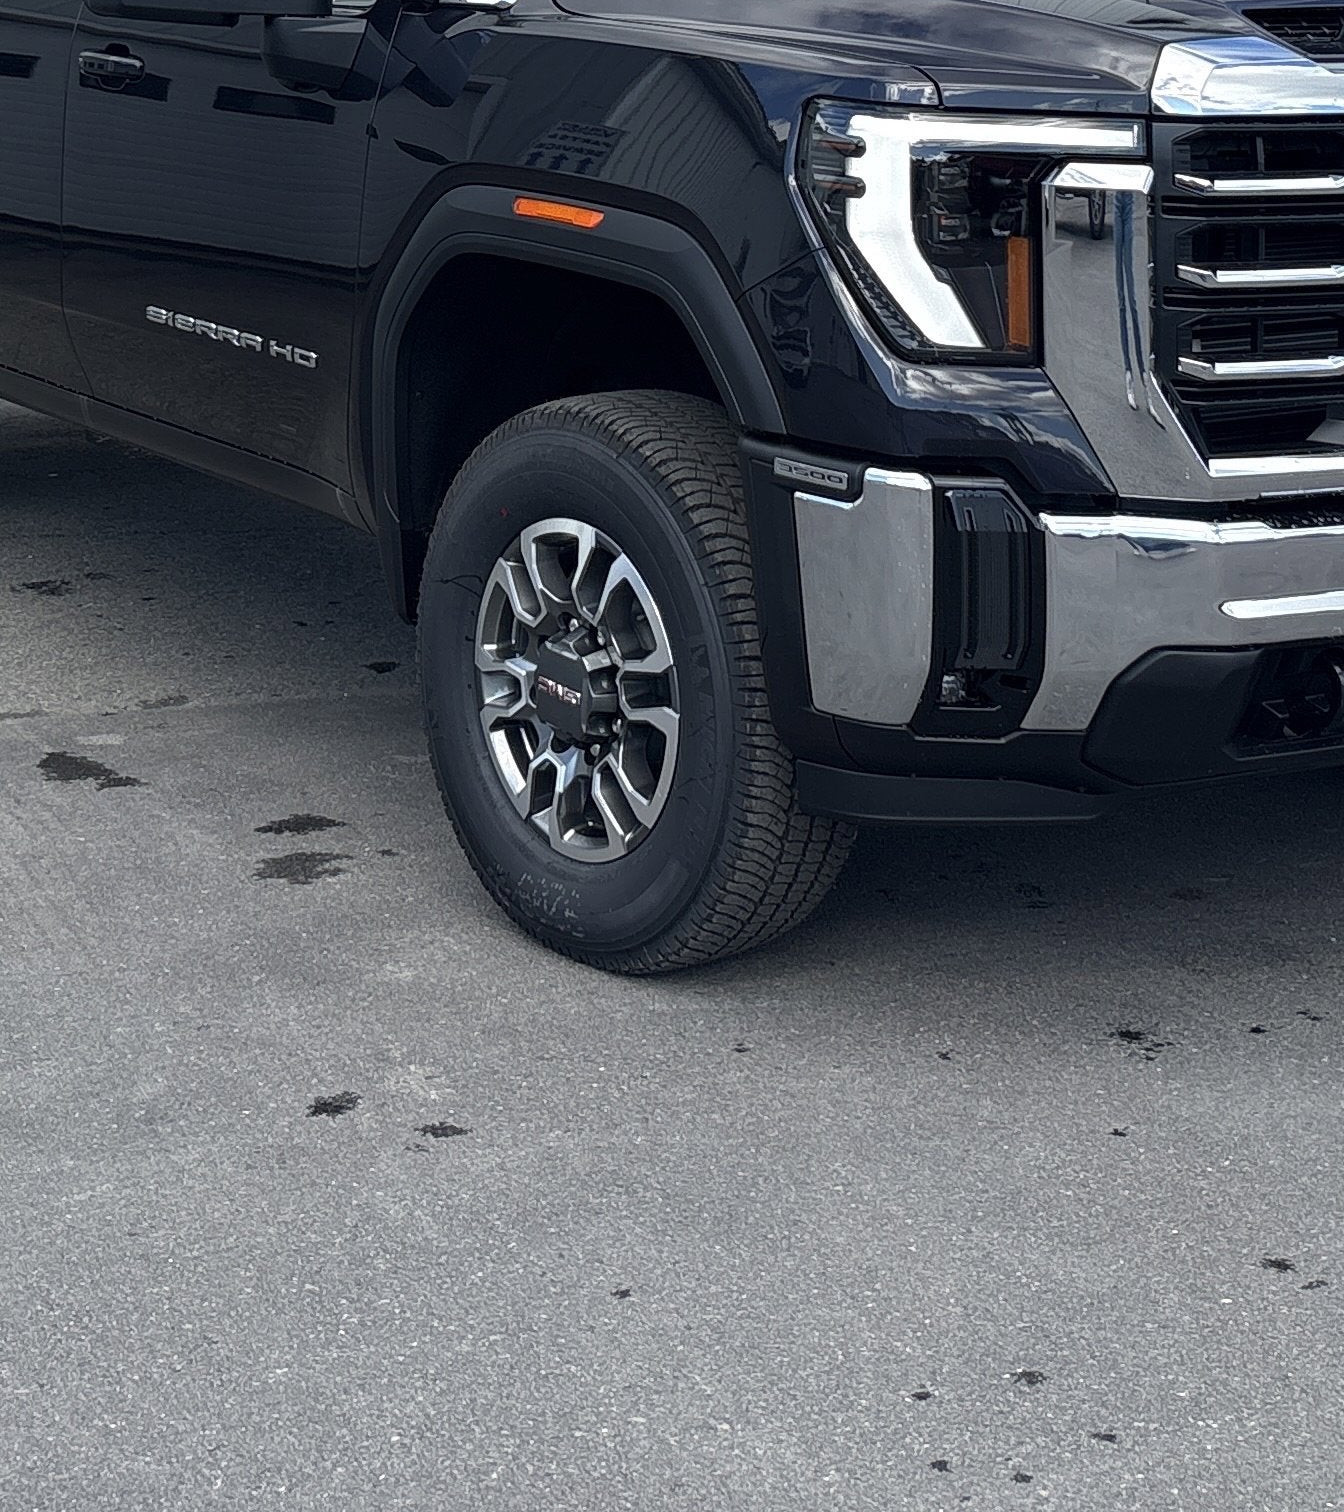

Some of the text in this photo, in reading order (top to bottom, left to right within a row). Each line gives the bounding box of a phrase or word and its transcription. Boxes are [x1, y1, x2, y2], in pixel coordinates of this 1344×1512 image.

[145, 305, 319, 369] SIERRA HD
[778, 462, 844, 484] 3500
